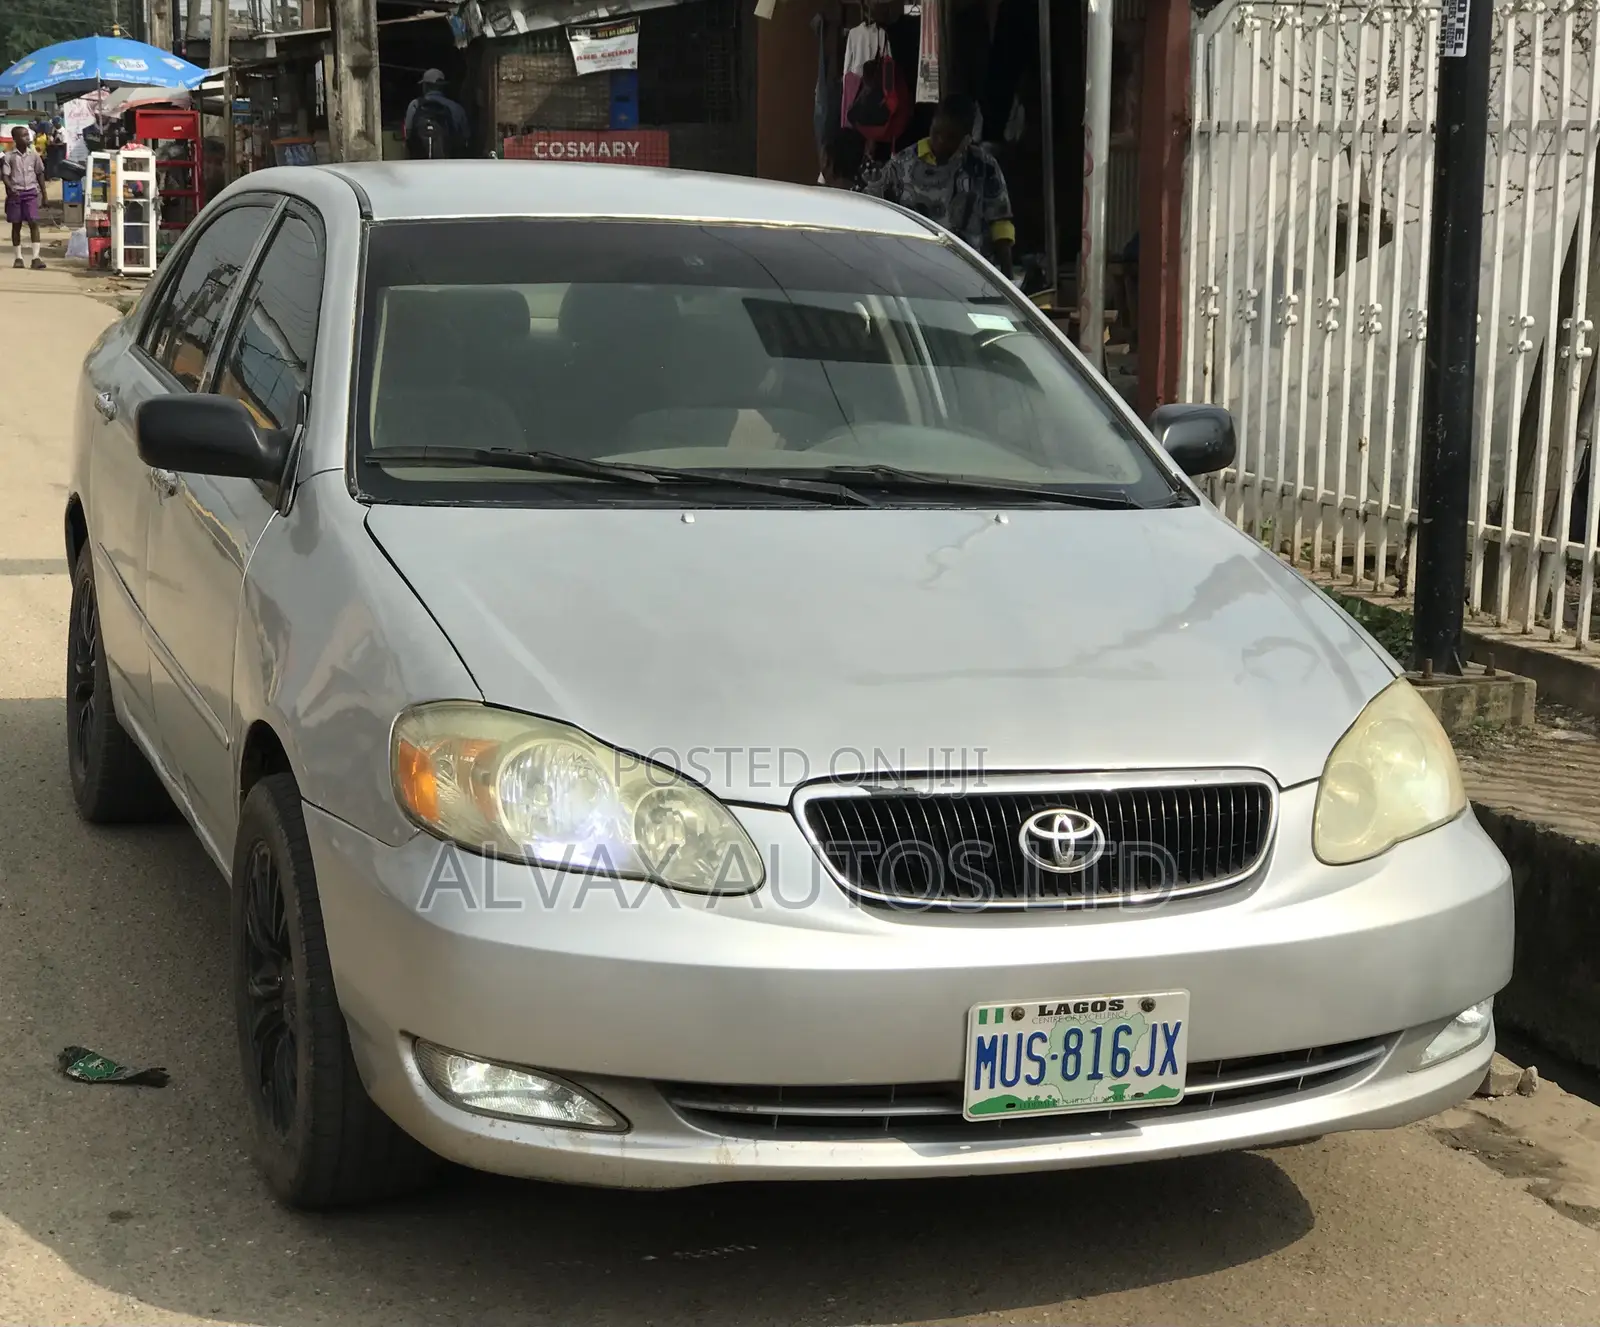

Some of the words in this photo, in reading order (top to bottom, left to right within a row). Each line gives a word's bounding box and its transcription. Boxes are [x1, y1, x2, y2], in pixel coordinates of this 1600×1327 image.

[534, 141, 639, 158] COSMARY
[1037, 999, 1125, 1017] LAGOS
[1031, 1014, 1062, 1025] CENTRE
[1079, 1010, 1129, 1021] EXCELLENCE
